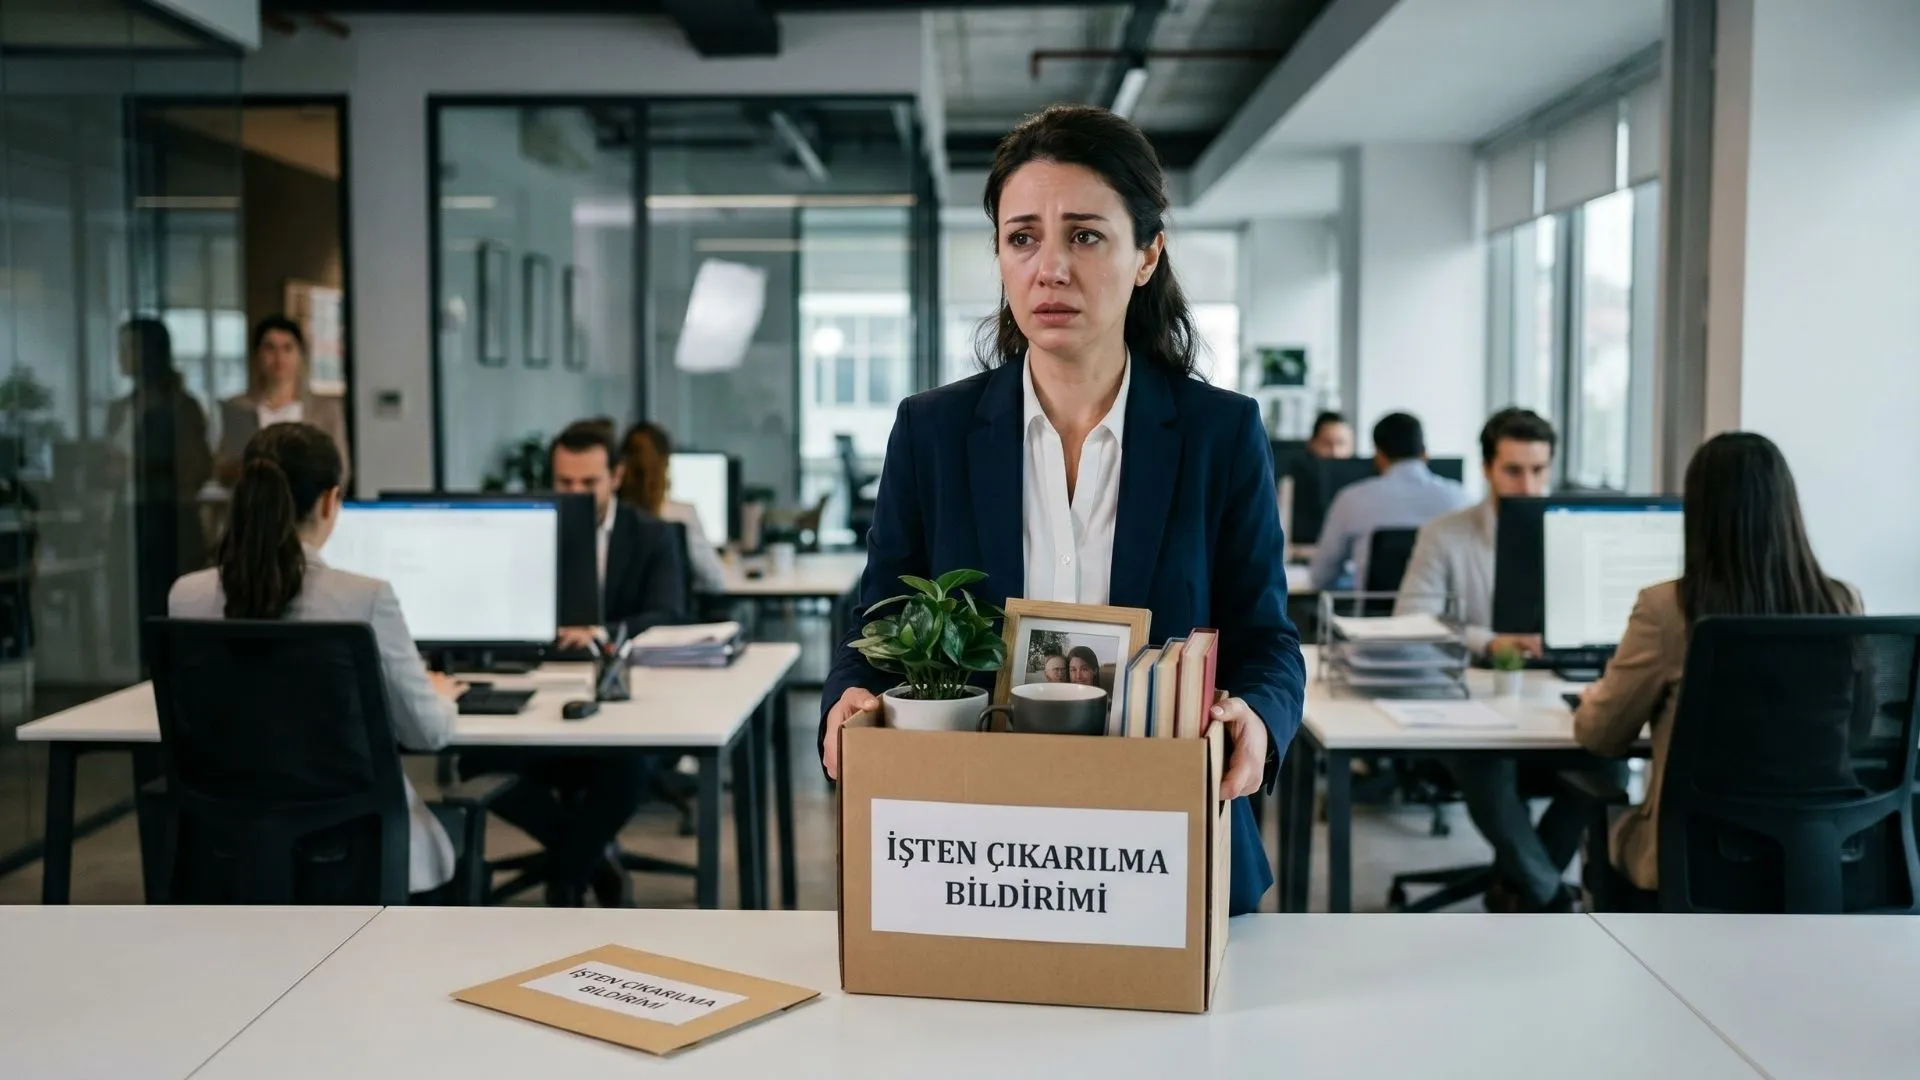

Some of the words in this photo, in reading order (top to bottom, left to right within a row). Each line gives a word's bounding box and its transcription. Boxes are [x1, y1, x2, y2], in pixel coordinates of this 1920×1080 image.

[887, 831, 977, 868] İŞTEN
[987, 842, 1169, 875] ÇIKARILMA
[944, 876, 1108, 914] BİLDİRİMİ
[569, 967, 623, 985] İŞTEN
[621, 980, 717, 1008] ÇIKARILMA
[578, 985, 667, 1010] BİLDİRİMİ
